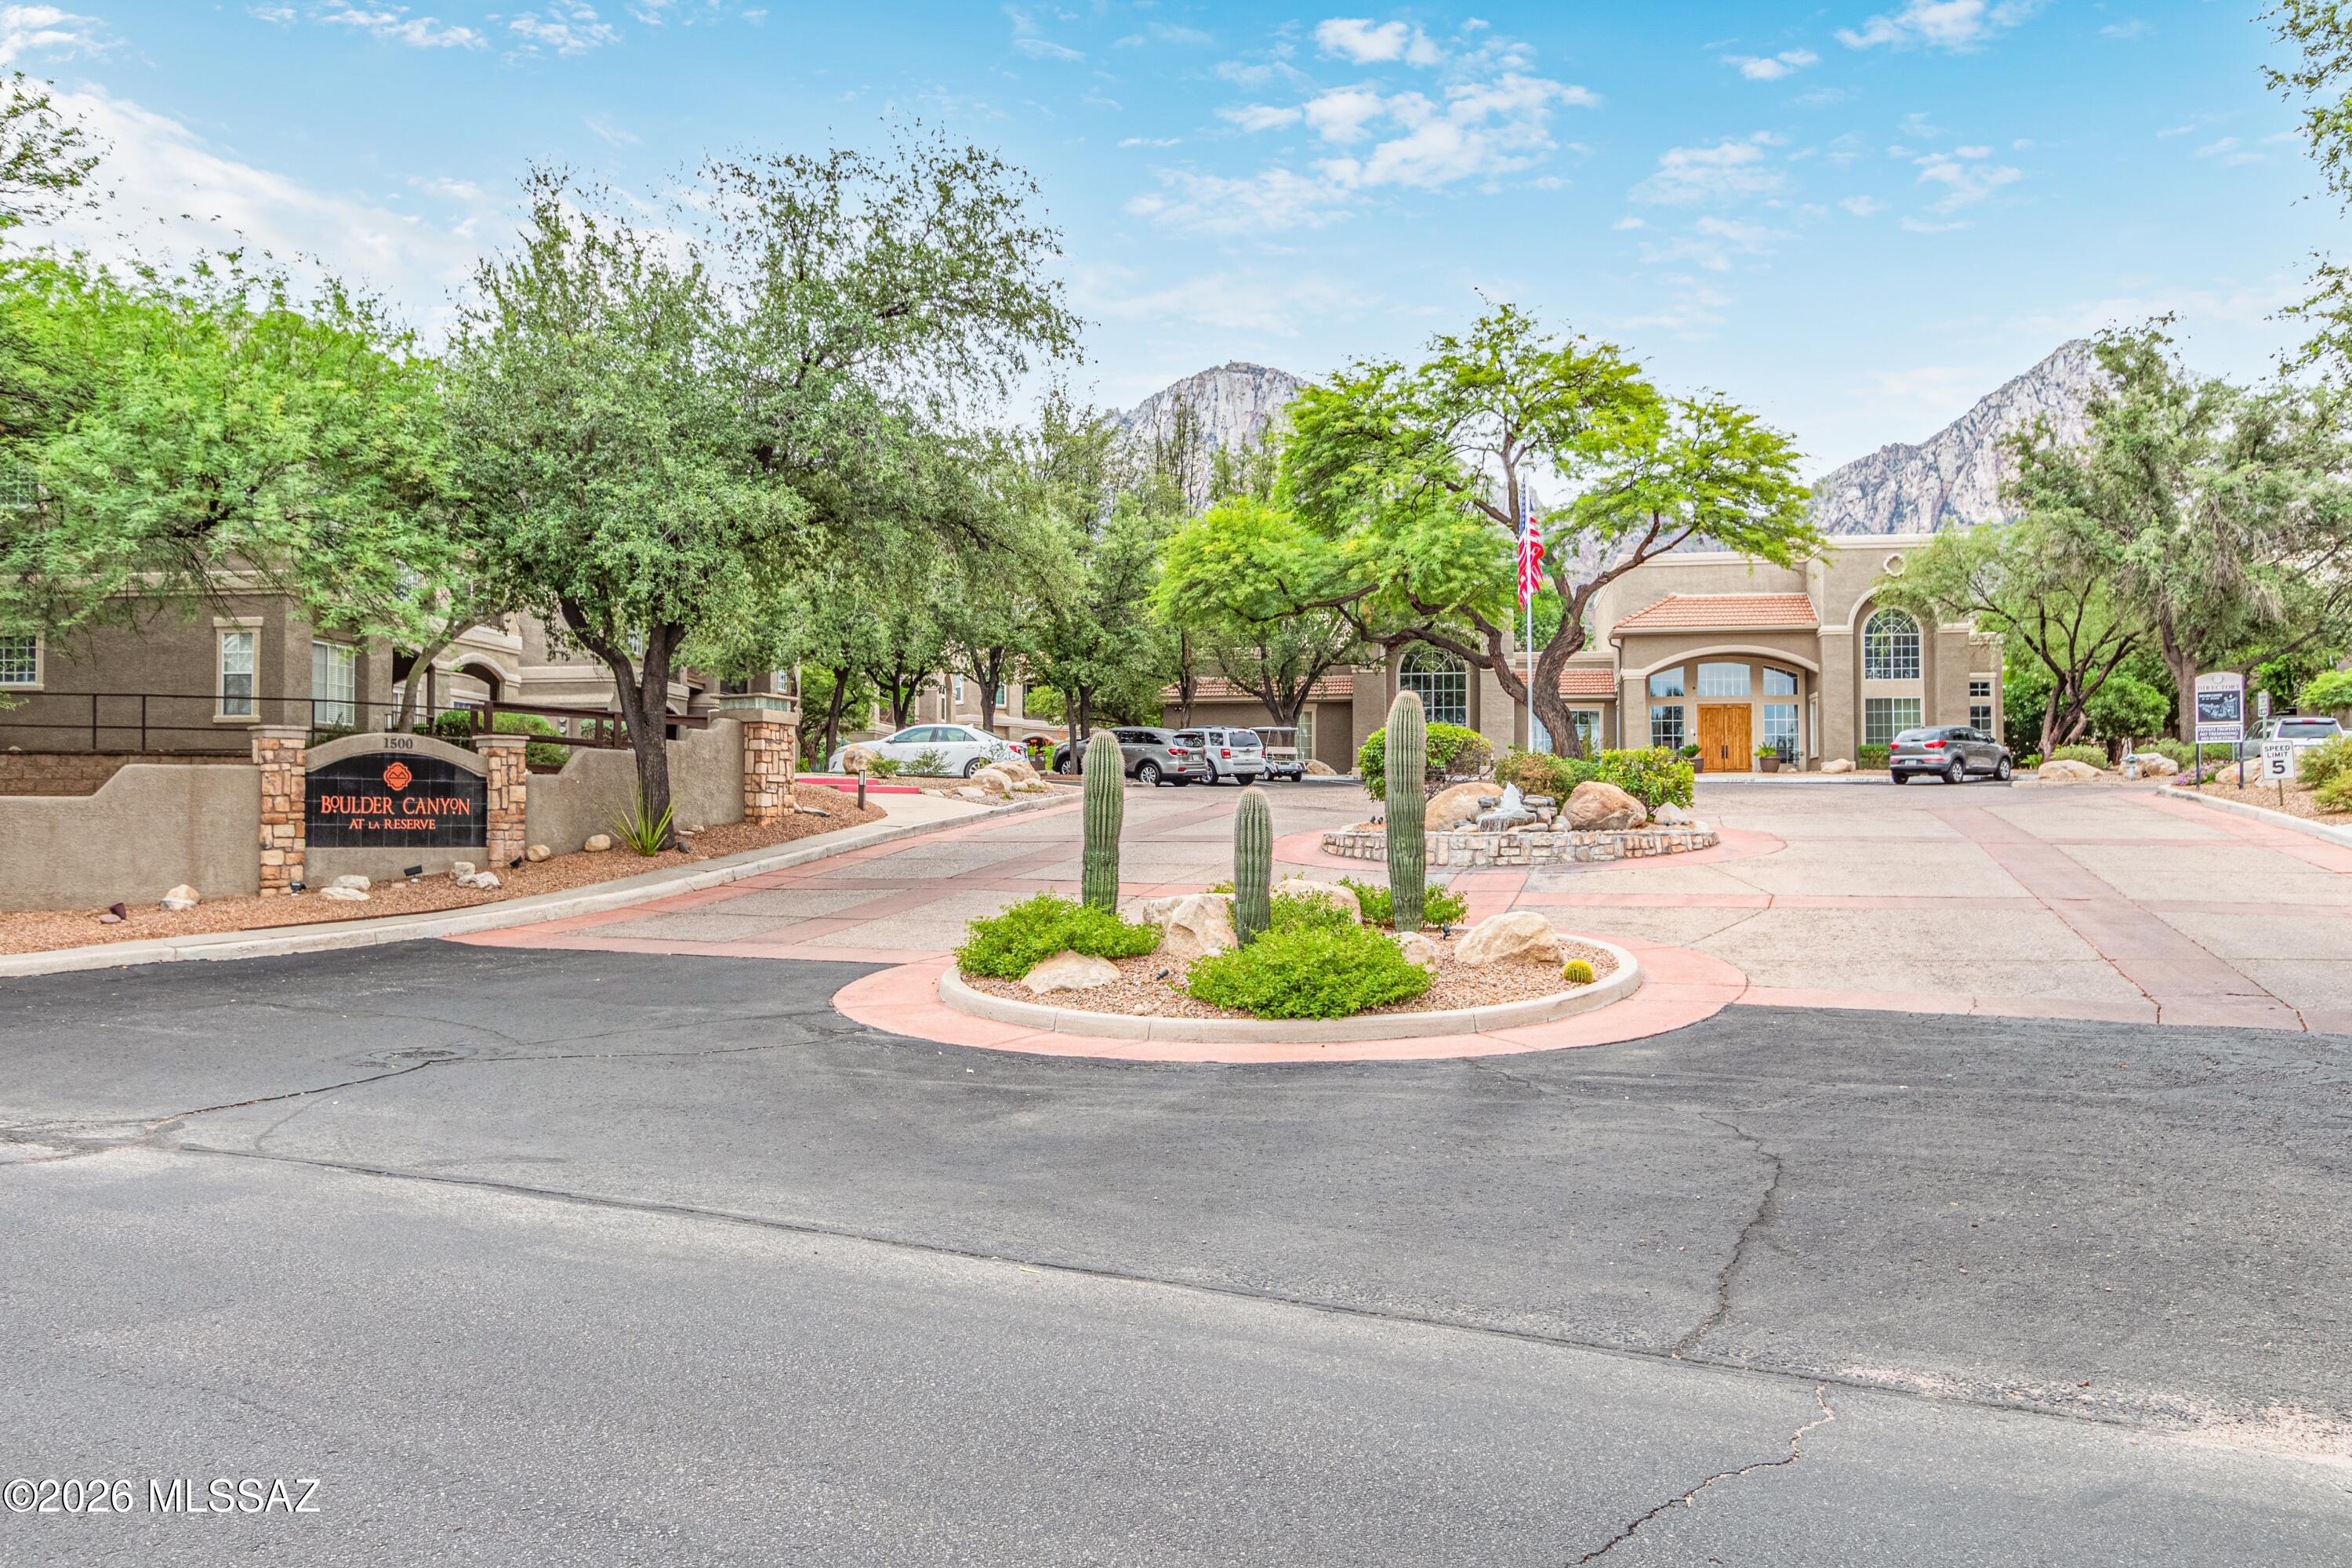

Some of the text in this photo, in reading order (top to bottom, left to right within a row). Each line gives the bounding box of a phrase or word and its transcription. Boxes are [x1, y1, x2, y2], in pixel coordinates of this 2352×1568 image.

[383, 738, 413, 750] 1500
[2272, 760, 2285, 774] 5
[321, 795, 470, 816] BOULDER CANYON
[349, 818, 436, 830] AT LA RESERVE
